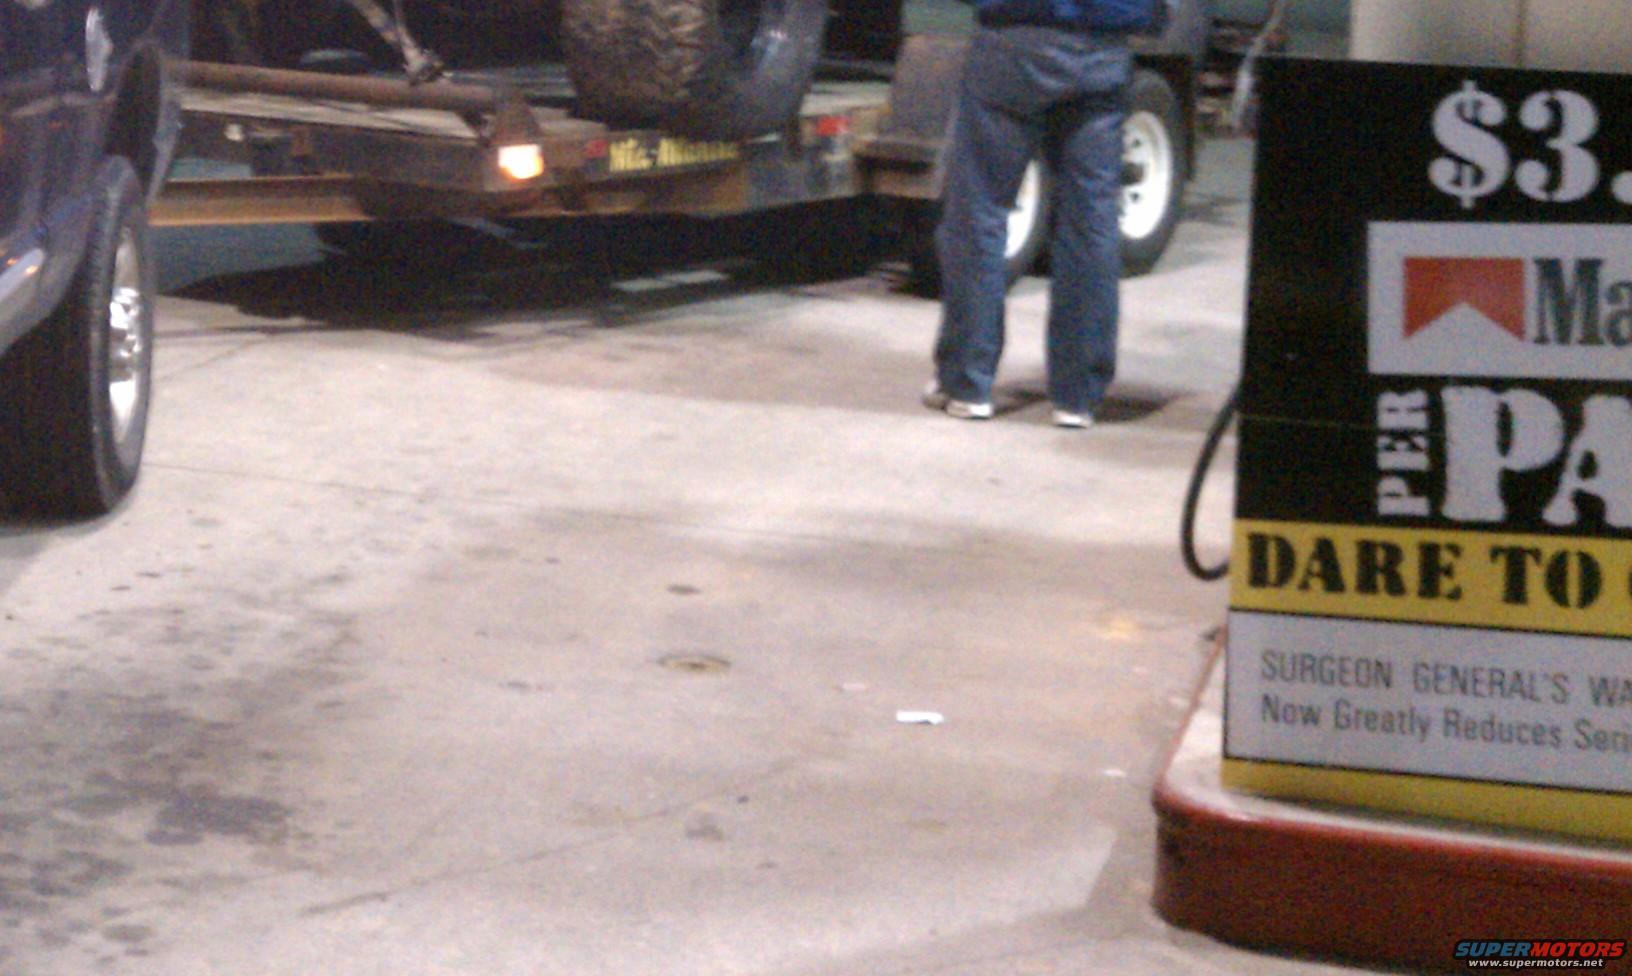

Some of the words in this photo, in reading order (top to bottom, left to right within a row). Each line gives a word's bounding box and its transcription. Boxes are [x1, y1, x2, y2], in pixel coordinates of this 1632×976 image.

[1376, 388, 1430, 516] PER
[1440, 385, 1632, 528] PA
[1247, 532, 1463, 601] DARE
[1490, 545, 1602, 609] TO
[1261, 650, 1392, 689] SURGEON
[1413, 662, 1569, 704] GENERAL'S
[1261, 693, 1322, 726] Now
[1334, 698, 1432, 743] Greatly
[1443, 707, 1562, 748] Reduces
